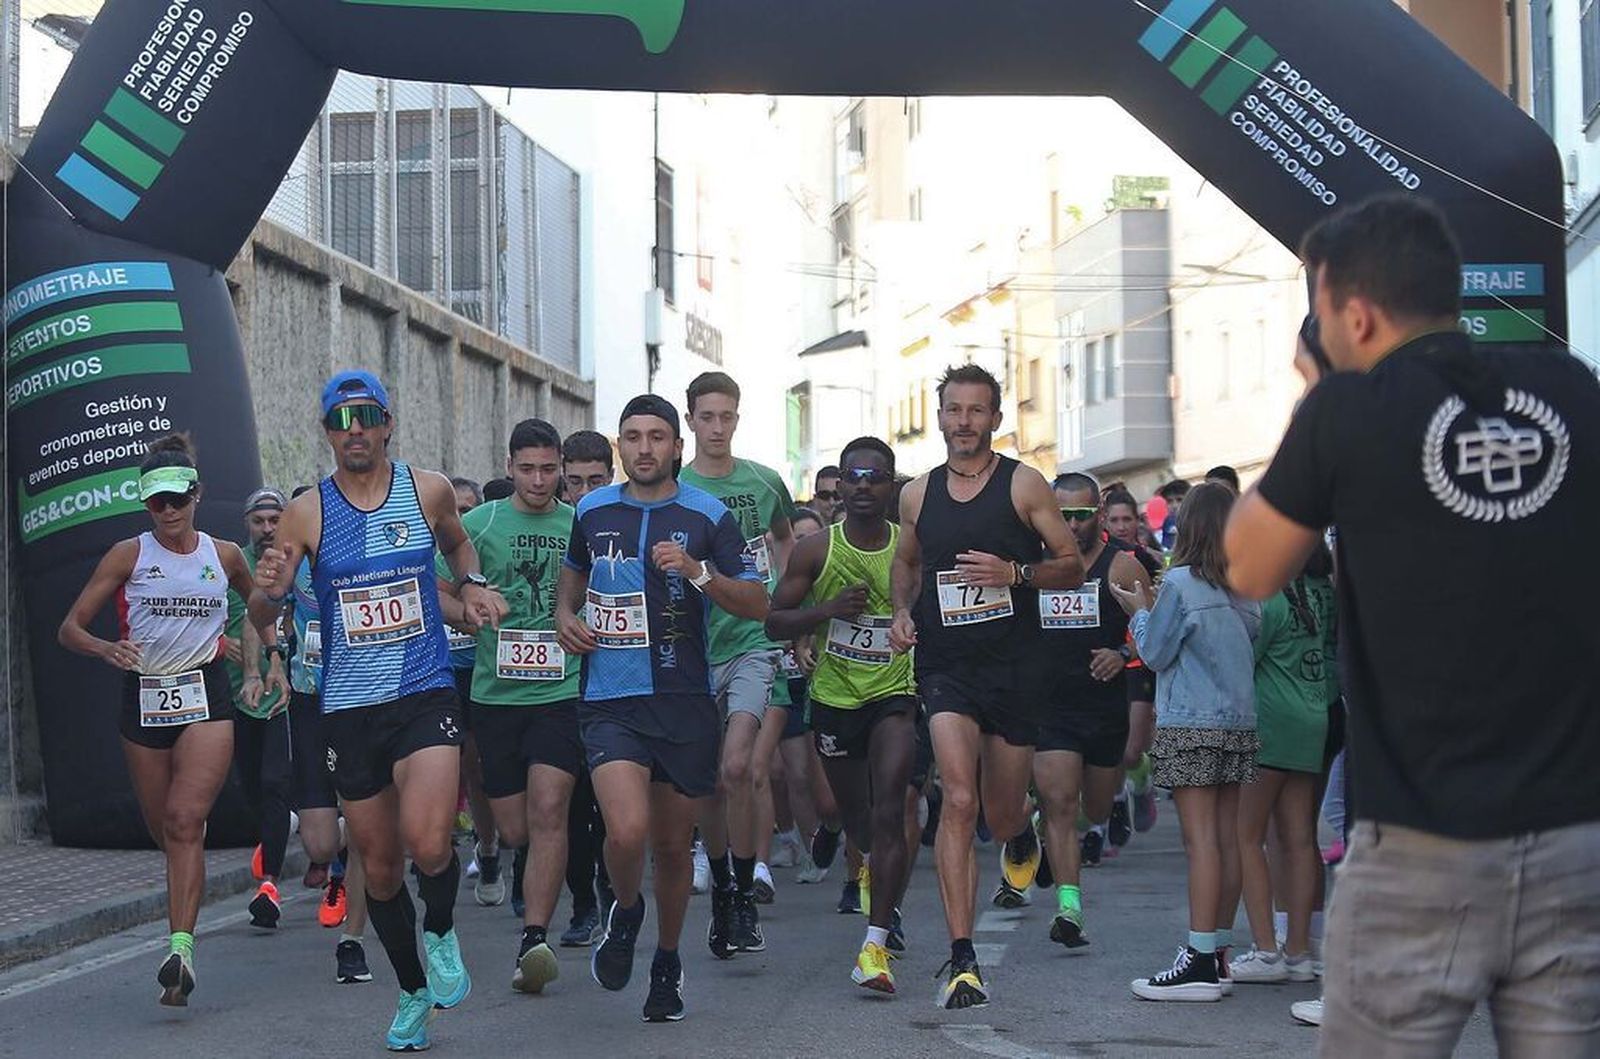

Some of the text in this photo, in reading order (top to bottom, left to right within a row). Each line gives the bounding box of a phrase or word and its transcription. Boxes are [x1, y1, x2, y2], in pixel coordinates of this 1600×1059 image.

[139, 8, 204, 101] FIABILIDAD
[177, 11, 254, 124] COMPROMISO
[158, 28, 218, 112] SERIEDAD
[1243, 94, 1324, 167] SERIEDAD
[1257, 78, 1346, 157] FIABILIDAD
[1273, 60, 1421, 190] PROFESIONALIDAD
[1230, 111, 1337, 206] COMPROMISO
[85, 394, 168, 418] Gestión y
[40, 415, 172, 457] cronometraje de
[29, 455, 79, 486] eventos
[517, 534, 567, 551] CROSS
[352, 569, 396, 584] Atletismo
[957, 585, 986, 608] 72
[1051, 595, 1084, 615] 324
[358, 598, 403, 628] 310
[594, 608, 628, 632] 375
[849, 625, 874, 649] 73
[511, 643, 548, 665] 328
[157, 689, 183, 711] 25
